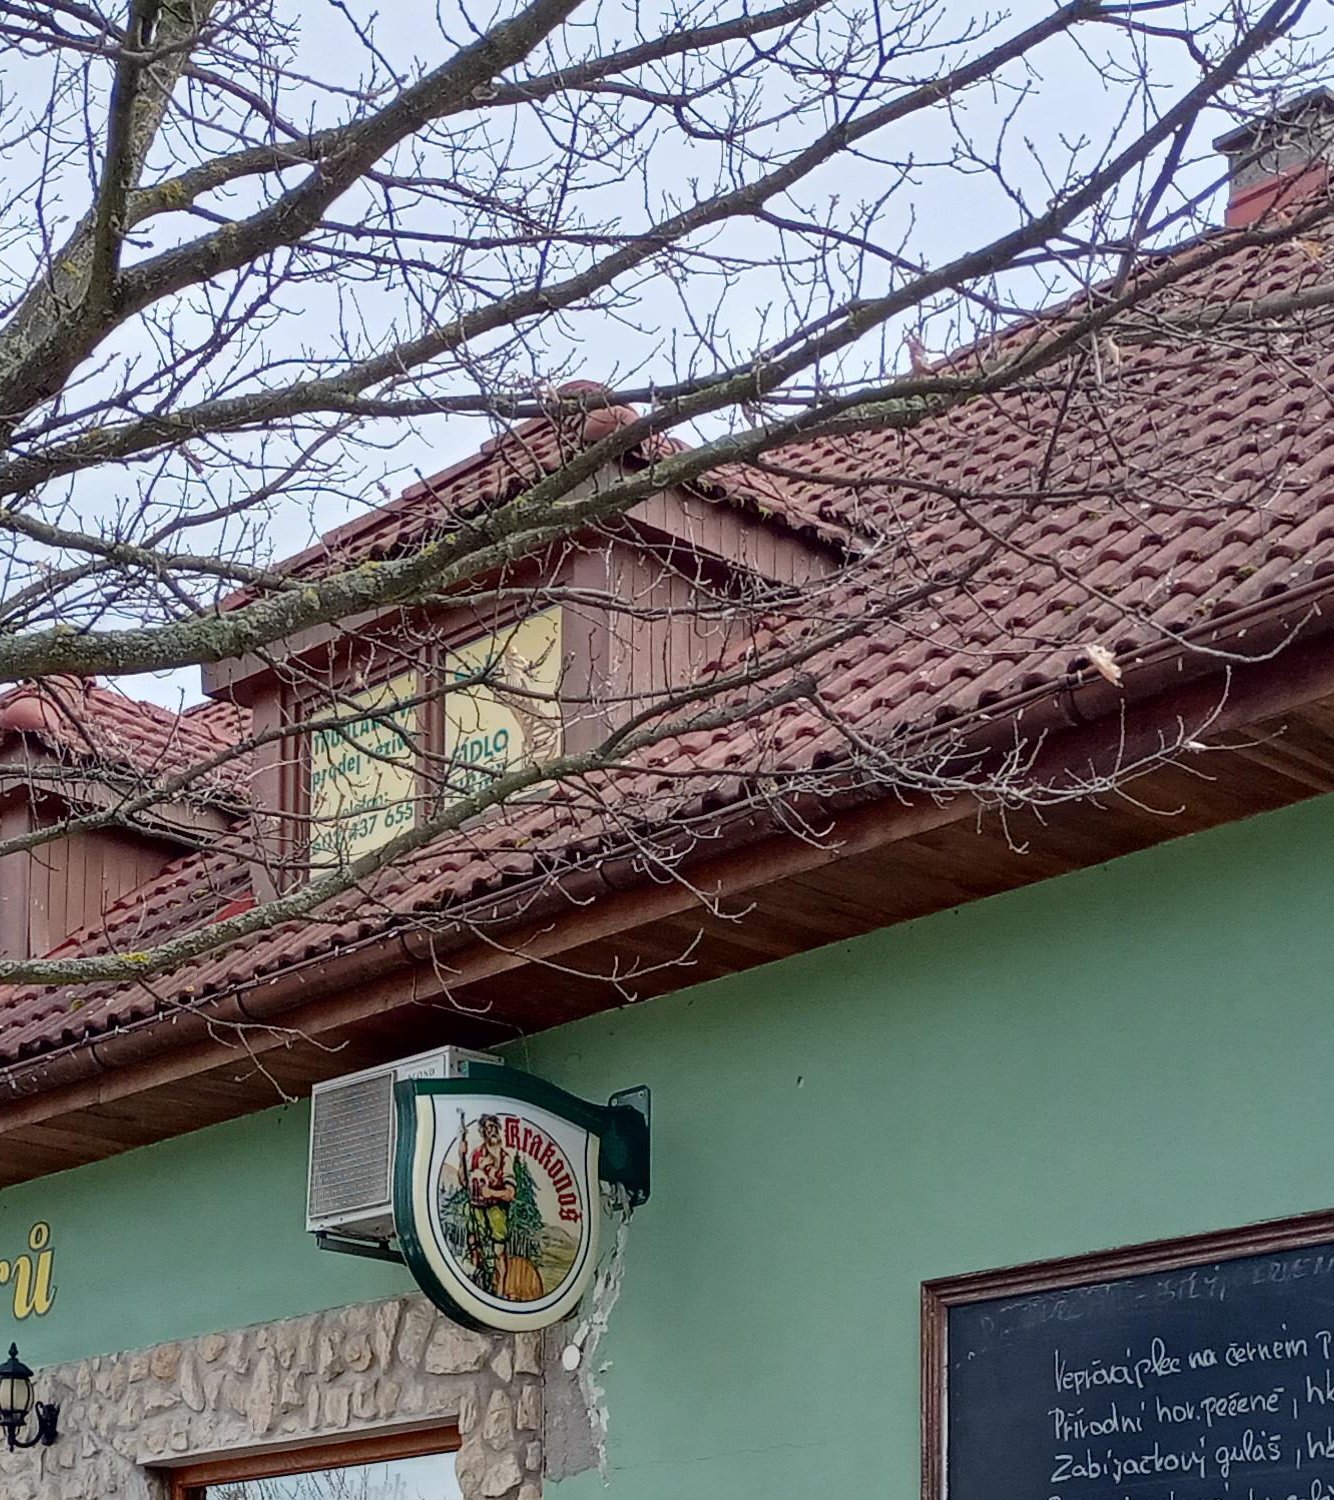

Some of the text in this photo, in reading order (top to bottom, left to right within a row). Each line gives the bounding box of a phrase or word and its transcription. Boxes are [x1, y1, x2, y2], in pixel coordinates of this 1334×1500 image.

[384, 802, 414, 828] 655
[505, 1117, 583, 1224] Krakonoš
[1188, 1348, 1218, 1369] na
